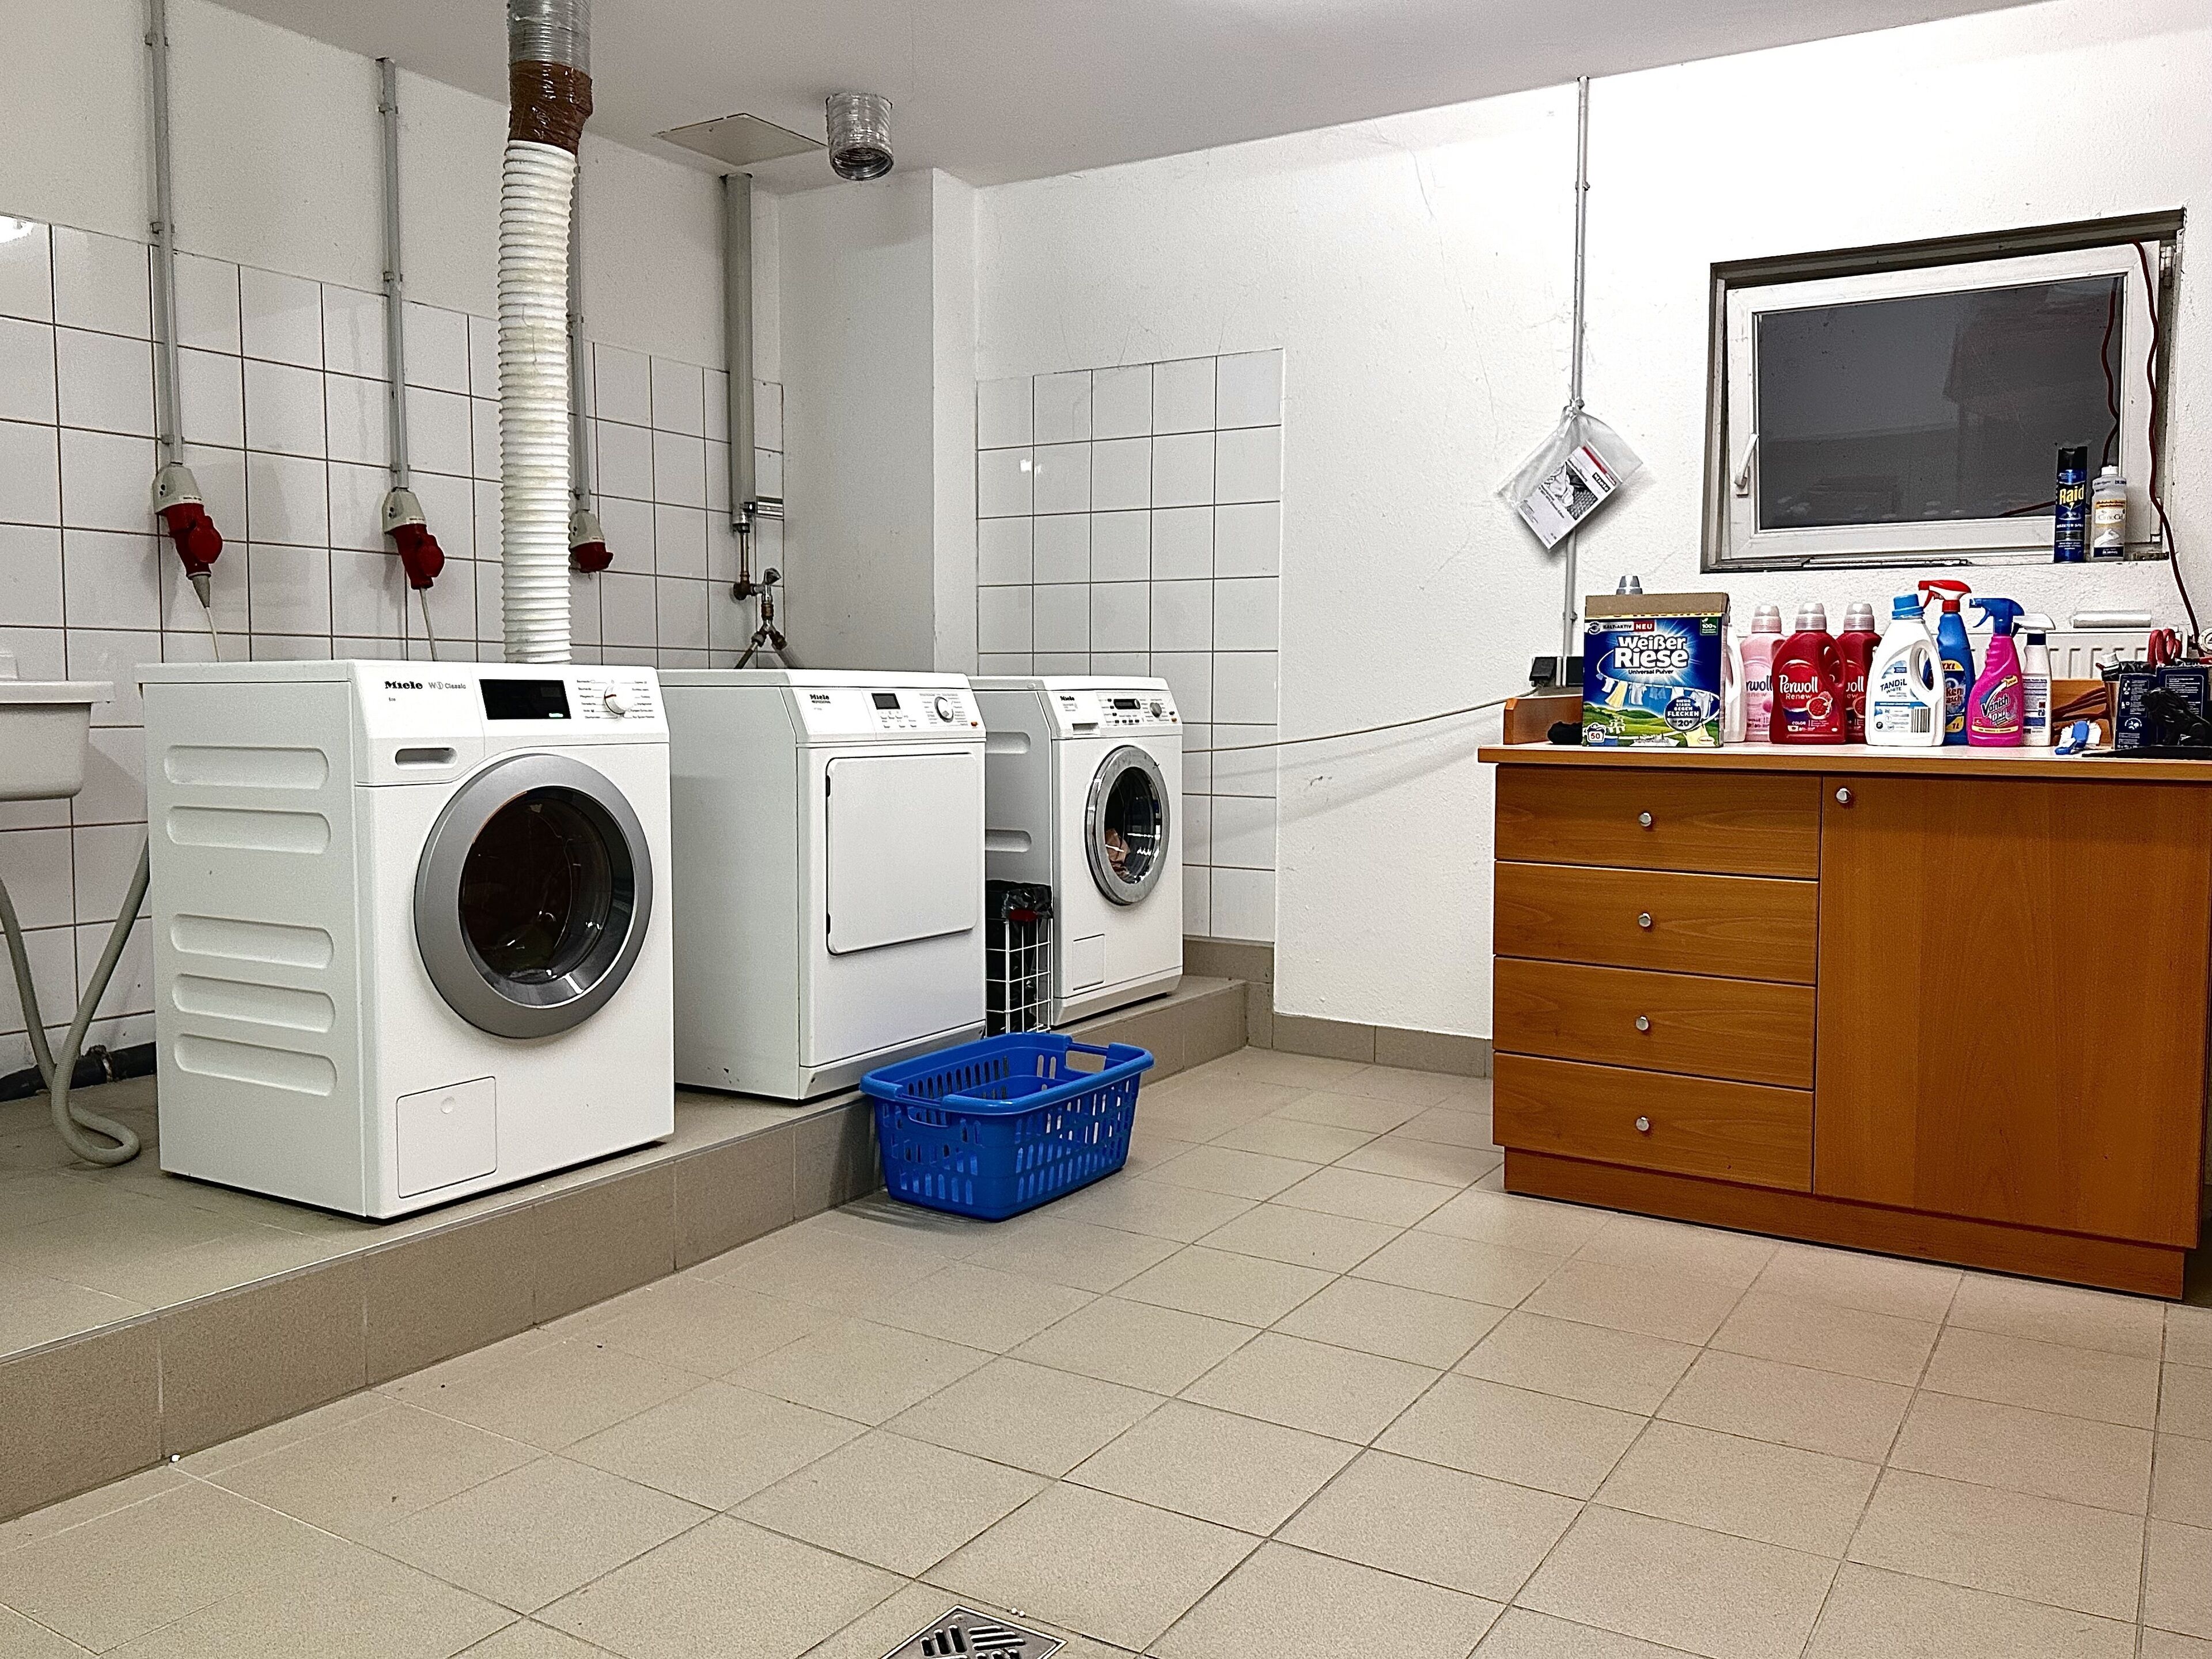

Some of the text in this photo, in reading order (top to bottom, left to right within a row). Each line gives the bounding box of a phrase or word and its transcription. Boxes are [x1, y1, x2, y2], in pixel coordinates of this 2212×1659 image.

[2059, 484, 2084, 505] Raid
[1618, 635, 1686, 650] Weißer
[1614, 647, 1688, 668] Riese
[384, 681, 423, 690] Miele
[1746, 675, 1772, 691] rwoll
[1779, 675, 1818, 693] Perwoll
[1982, 694, 2009, 717] Vanish
